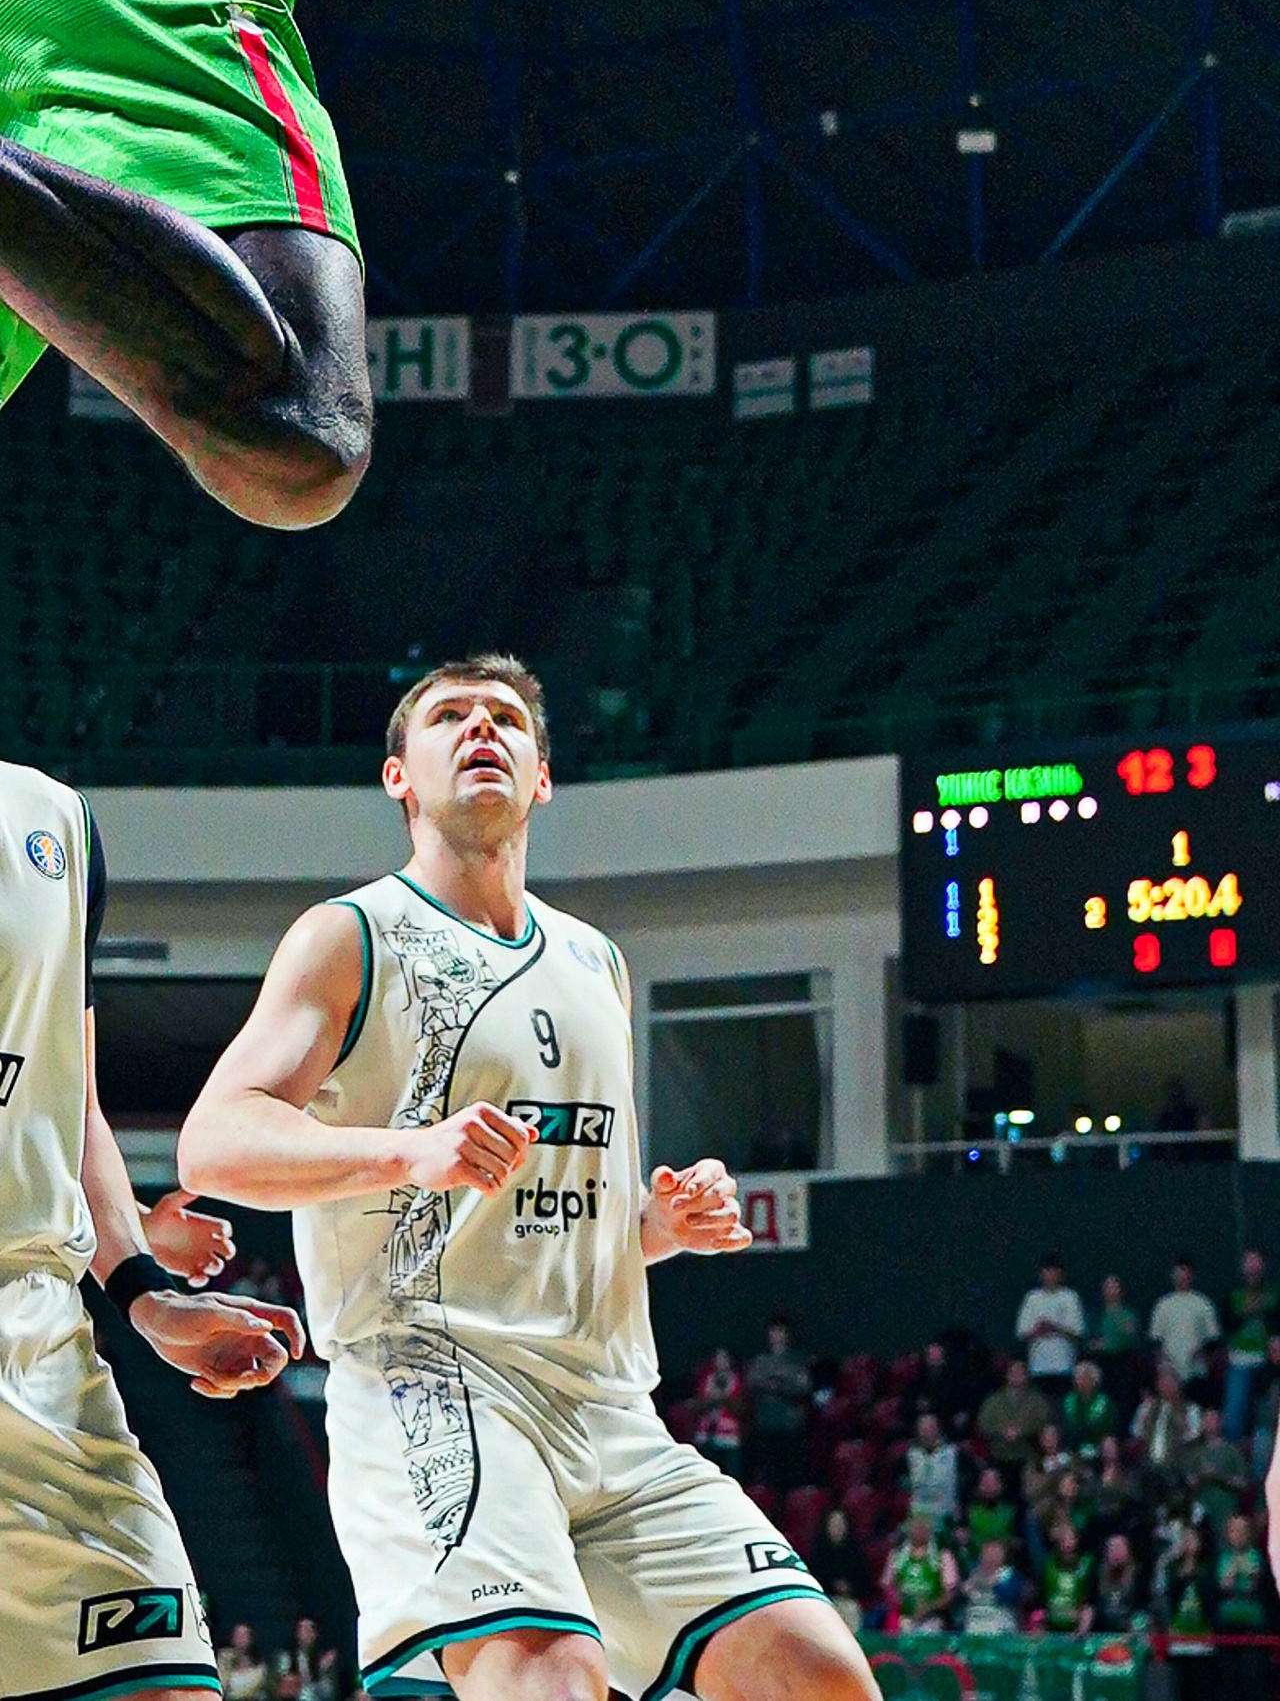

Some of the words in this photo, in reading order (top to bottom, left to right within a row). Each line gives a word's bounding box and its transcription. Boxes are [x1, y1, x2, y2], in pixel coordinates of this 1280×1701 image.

[1172, 829, 1191, 867] 1
[1127, 872, 1243, 923] 5:20.4
[529, 1007, 562, 1069] 9
[514, 1223, 561, 1239] group
